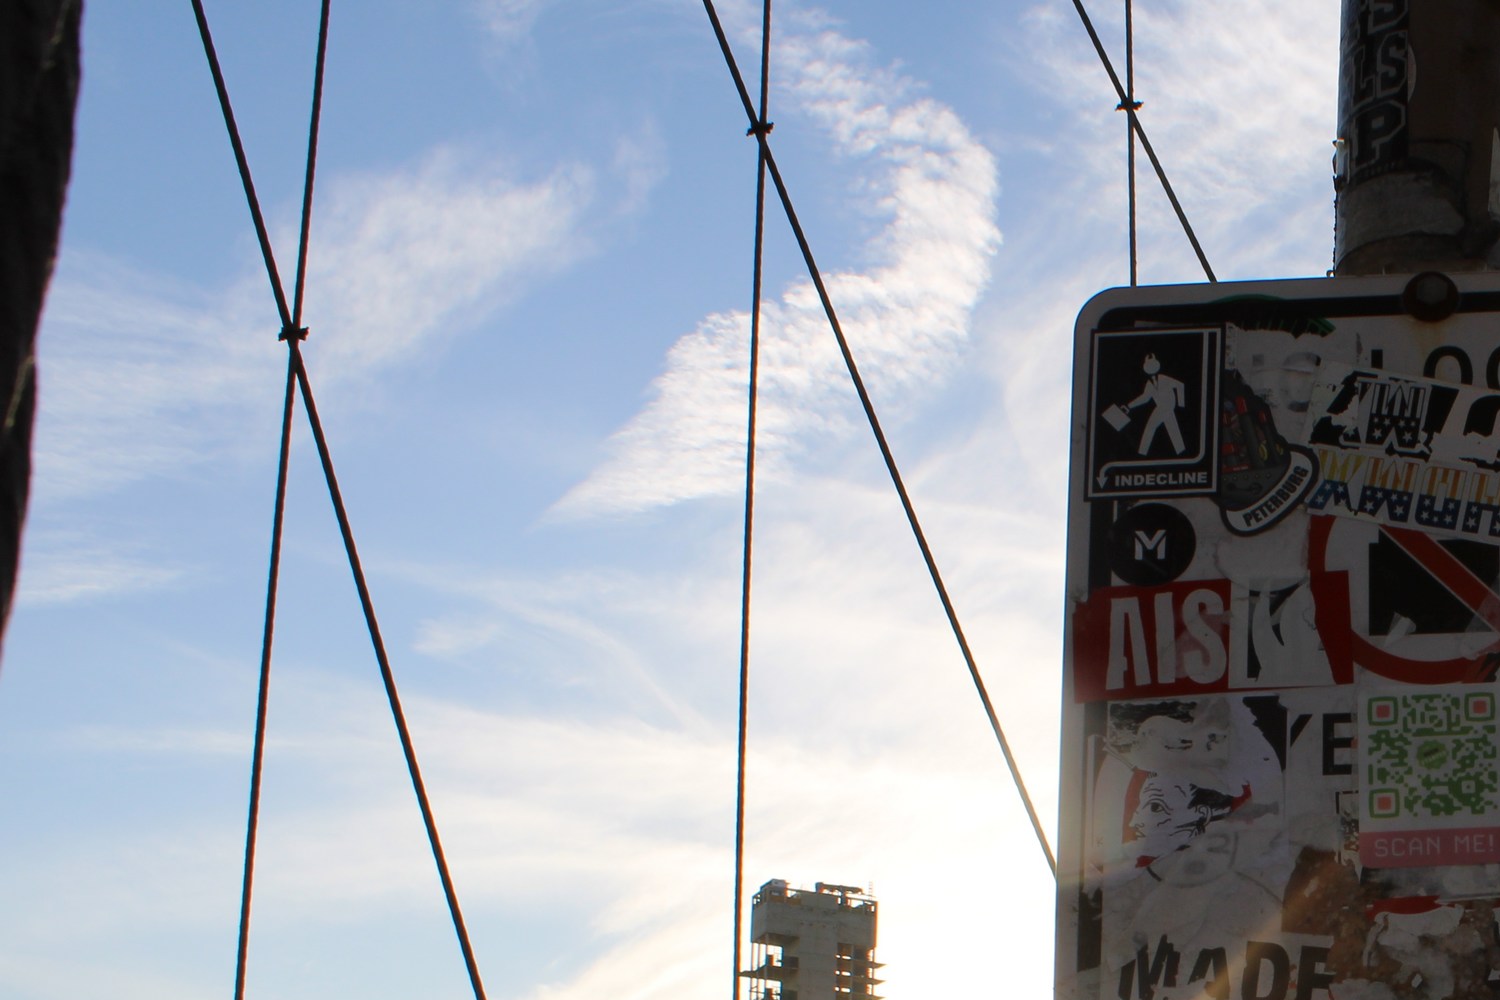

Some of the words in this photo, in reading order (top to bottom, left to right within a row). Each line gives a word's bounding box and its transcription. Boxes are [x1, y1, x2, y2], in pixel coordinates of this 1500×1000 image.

[1114, 471, 1208, 487] INDECLINE
[1241, 464, 1309, 527] PETERBURG
[1374, 836, 1441, 858] SCAN
[1454, 833, 1494, 854] ME!
